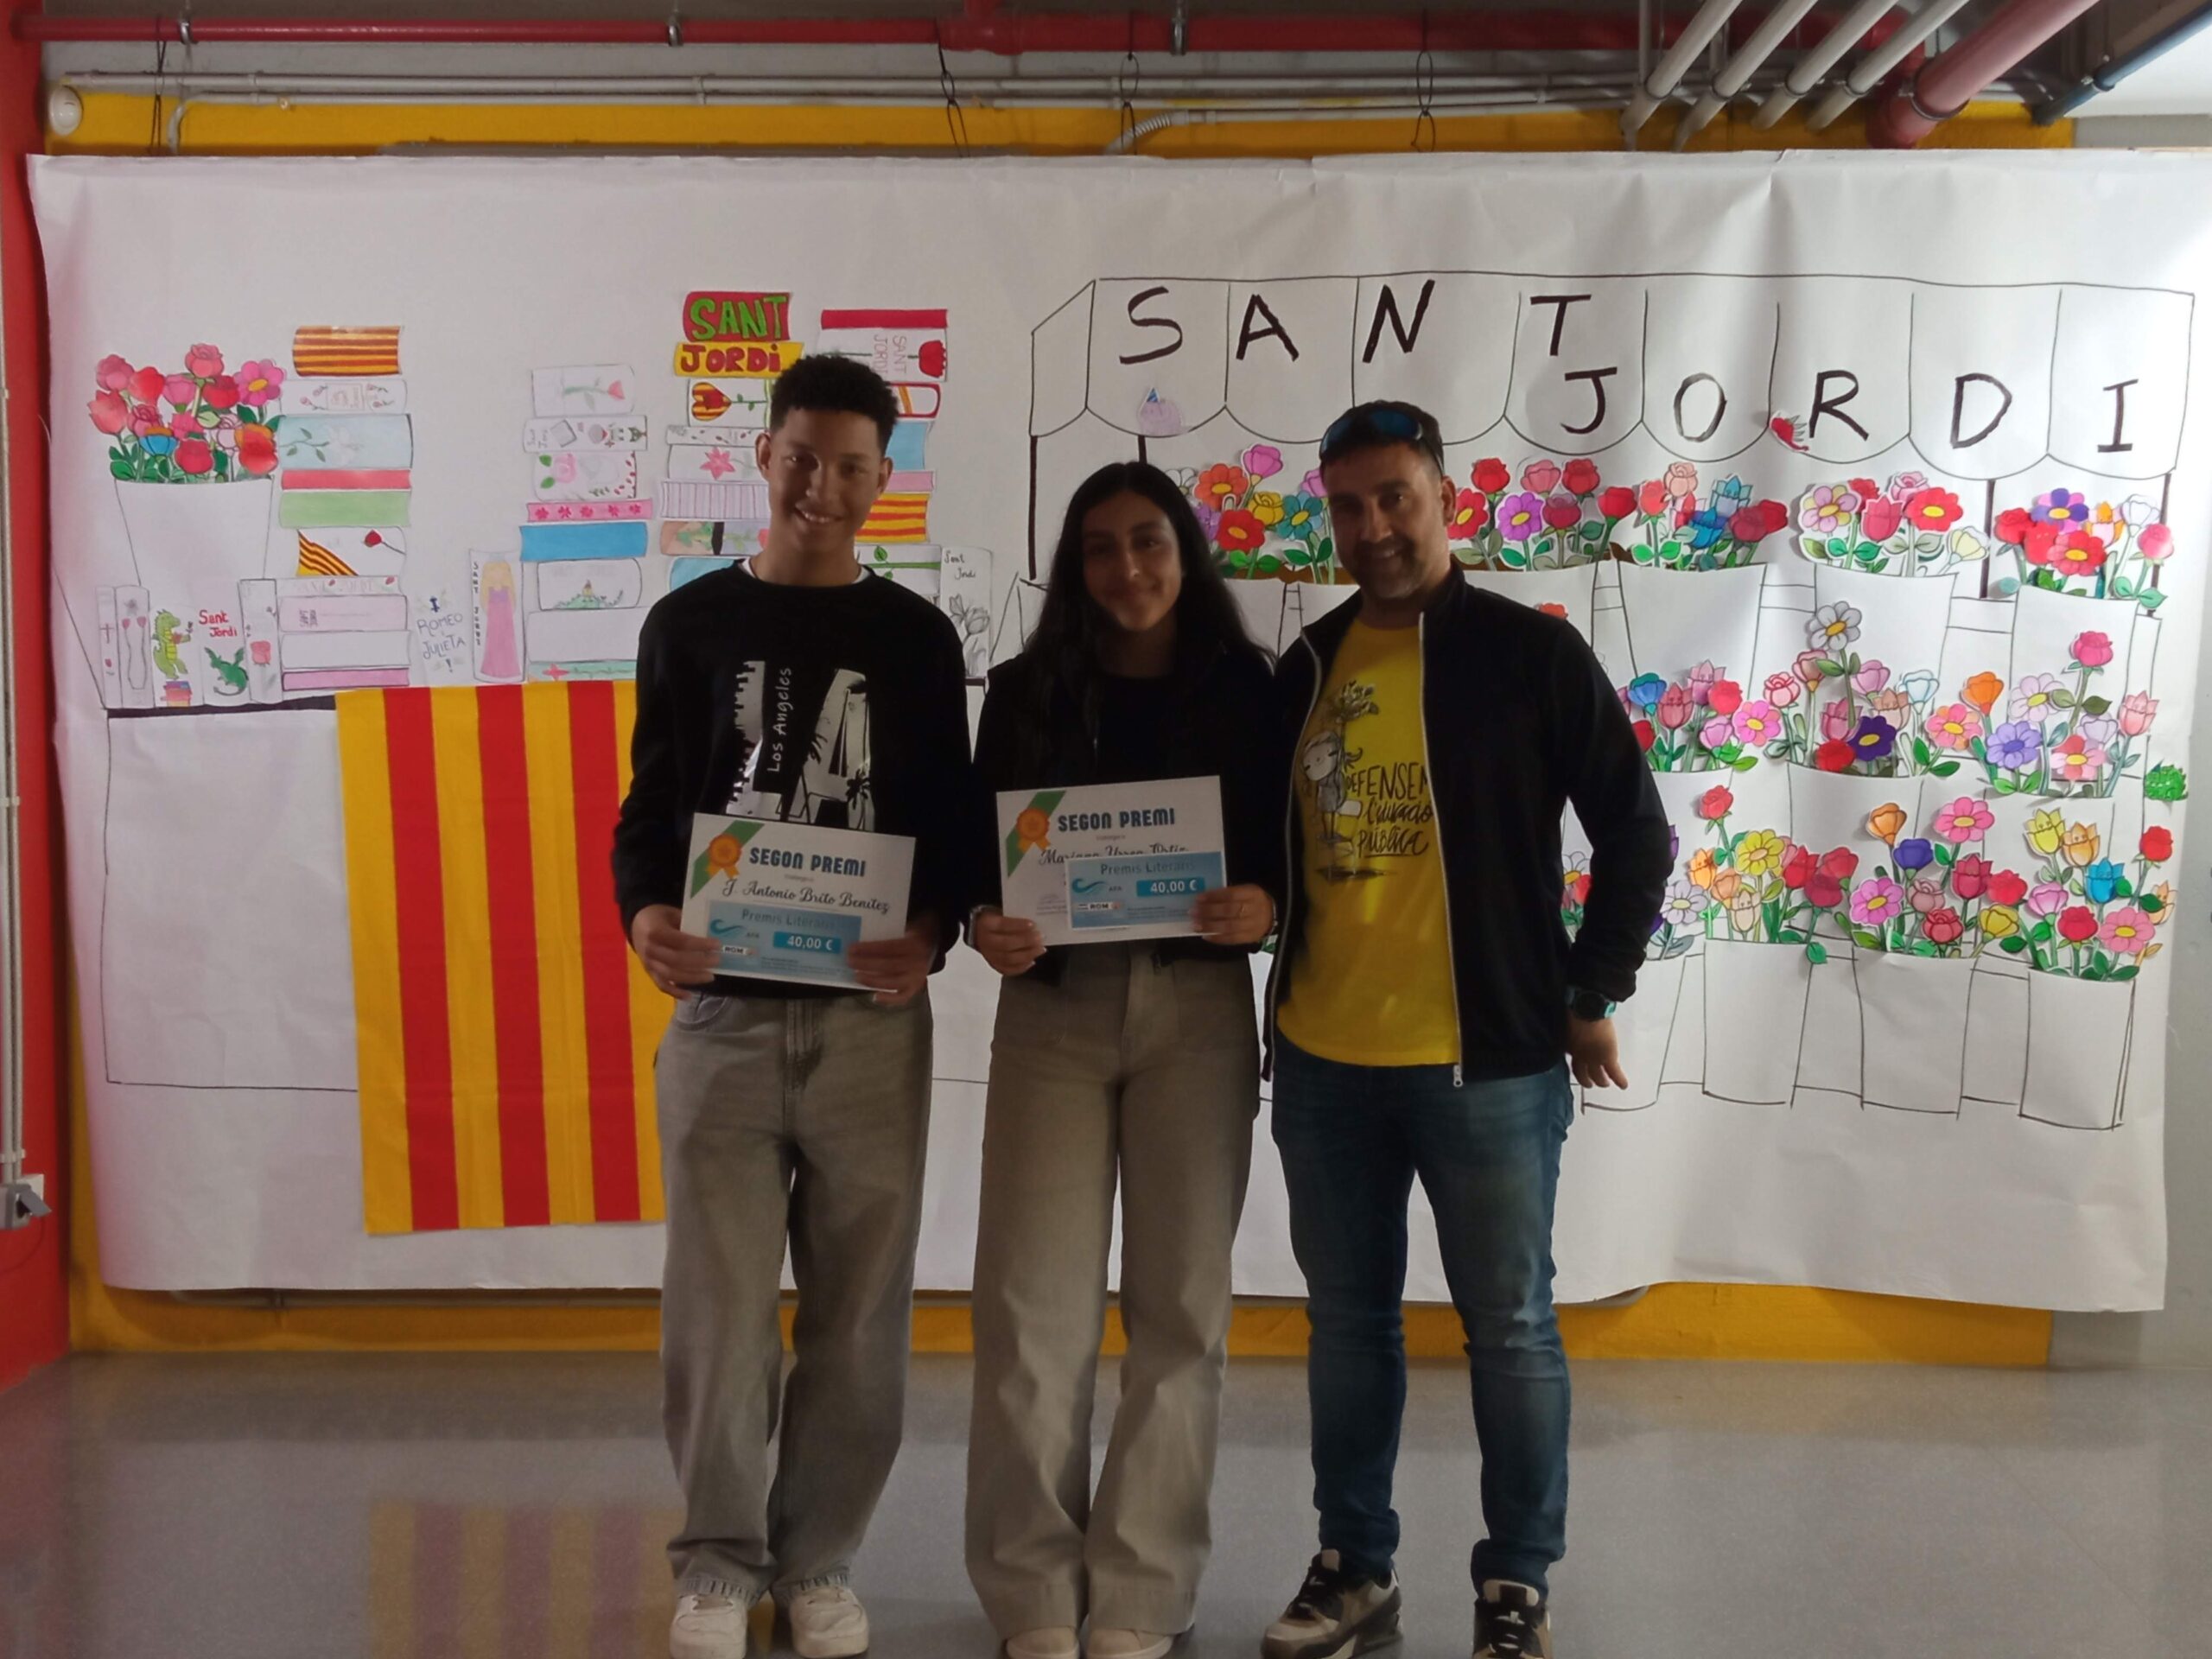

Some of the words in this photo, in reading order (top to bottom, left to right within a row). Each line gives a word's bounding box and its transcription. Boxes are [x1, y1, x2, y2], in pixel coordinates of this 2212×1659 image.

[690, 295, 787, 340] SANT
[1119, 279, 1592, 364] SANT
[873, 334, 889, 374] JORDI
[892, 334, 908, 374] SANT
[1560, 366, 2139, 454] JORDI
[198, 609, 230, 625] Sant
[416, 613, 463, 637] ROMEO
[208, 626, 238, 638] Jordi
[422, 634, 467, 659] JULIETA
[772, 667, 794, 735] Angeles
[766, 742, 784, 772] Los
[1058, 811, 1113, 832] SEGON
[1119, 807, 1176, 828] PREMI
[749, 846, 804, 870] SEGON
[810, 854, 867, 877] PREMI
[1100, 862, 1142, 876] Premis
[741, 880, 797, 900] Antonio
[799, 887, 836, 906] Brito
[741, 907, 782, 925] Premis
[787, 935, 822, 949] 40,00
